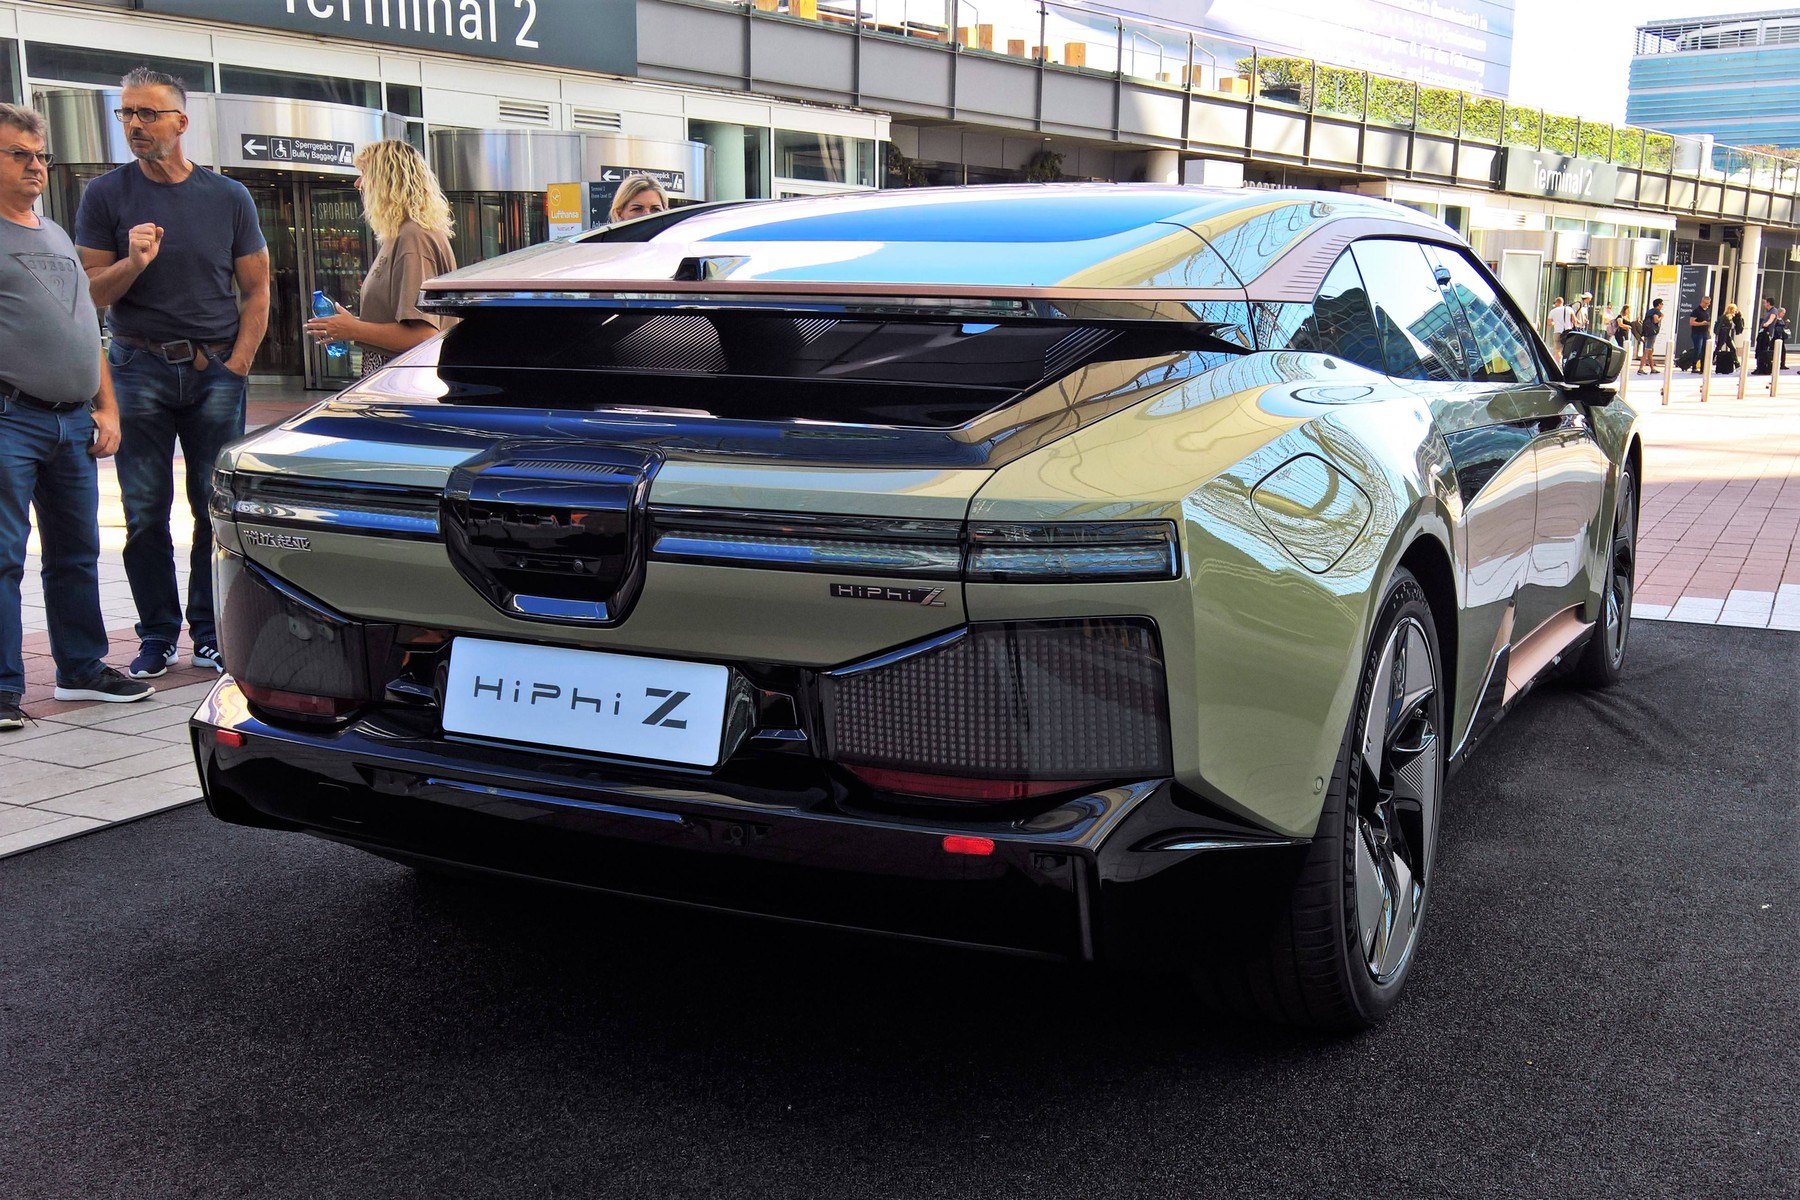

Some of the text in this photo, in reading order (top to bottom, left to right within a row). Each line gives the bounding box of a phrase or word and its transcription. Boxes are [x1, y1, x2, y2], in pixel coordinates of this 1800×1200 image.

[286, 0, 539, 49] rminal 2
[292, 150, 338, 162] Bulky Baggage
[295, 140, 334, 151] Sperrgepäck
[1533, 159, 1593, 196] Terminal 2
[551, 209, 579, 219] Lufthansa
[838, 585, 946, 607] HiPhi Z
[473, 675, 692, 730] HiPhi Z
[1344, 751, 1361, 909] MICHELIN
